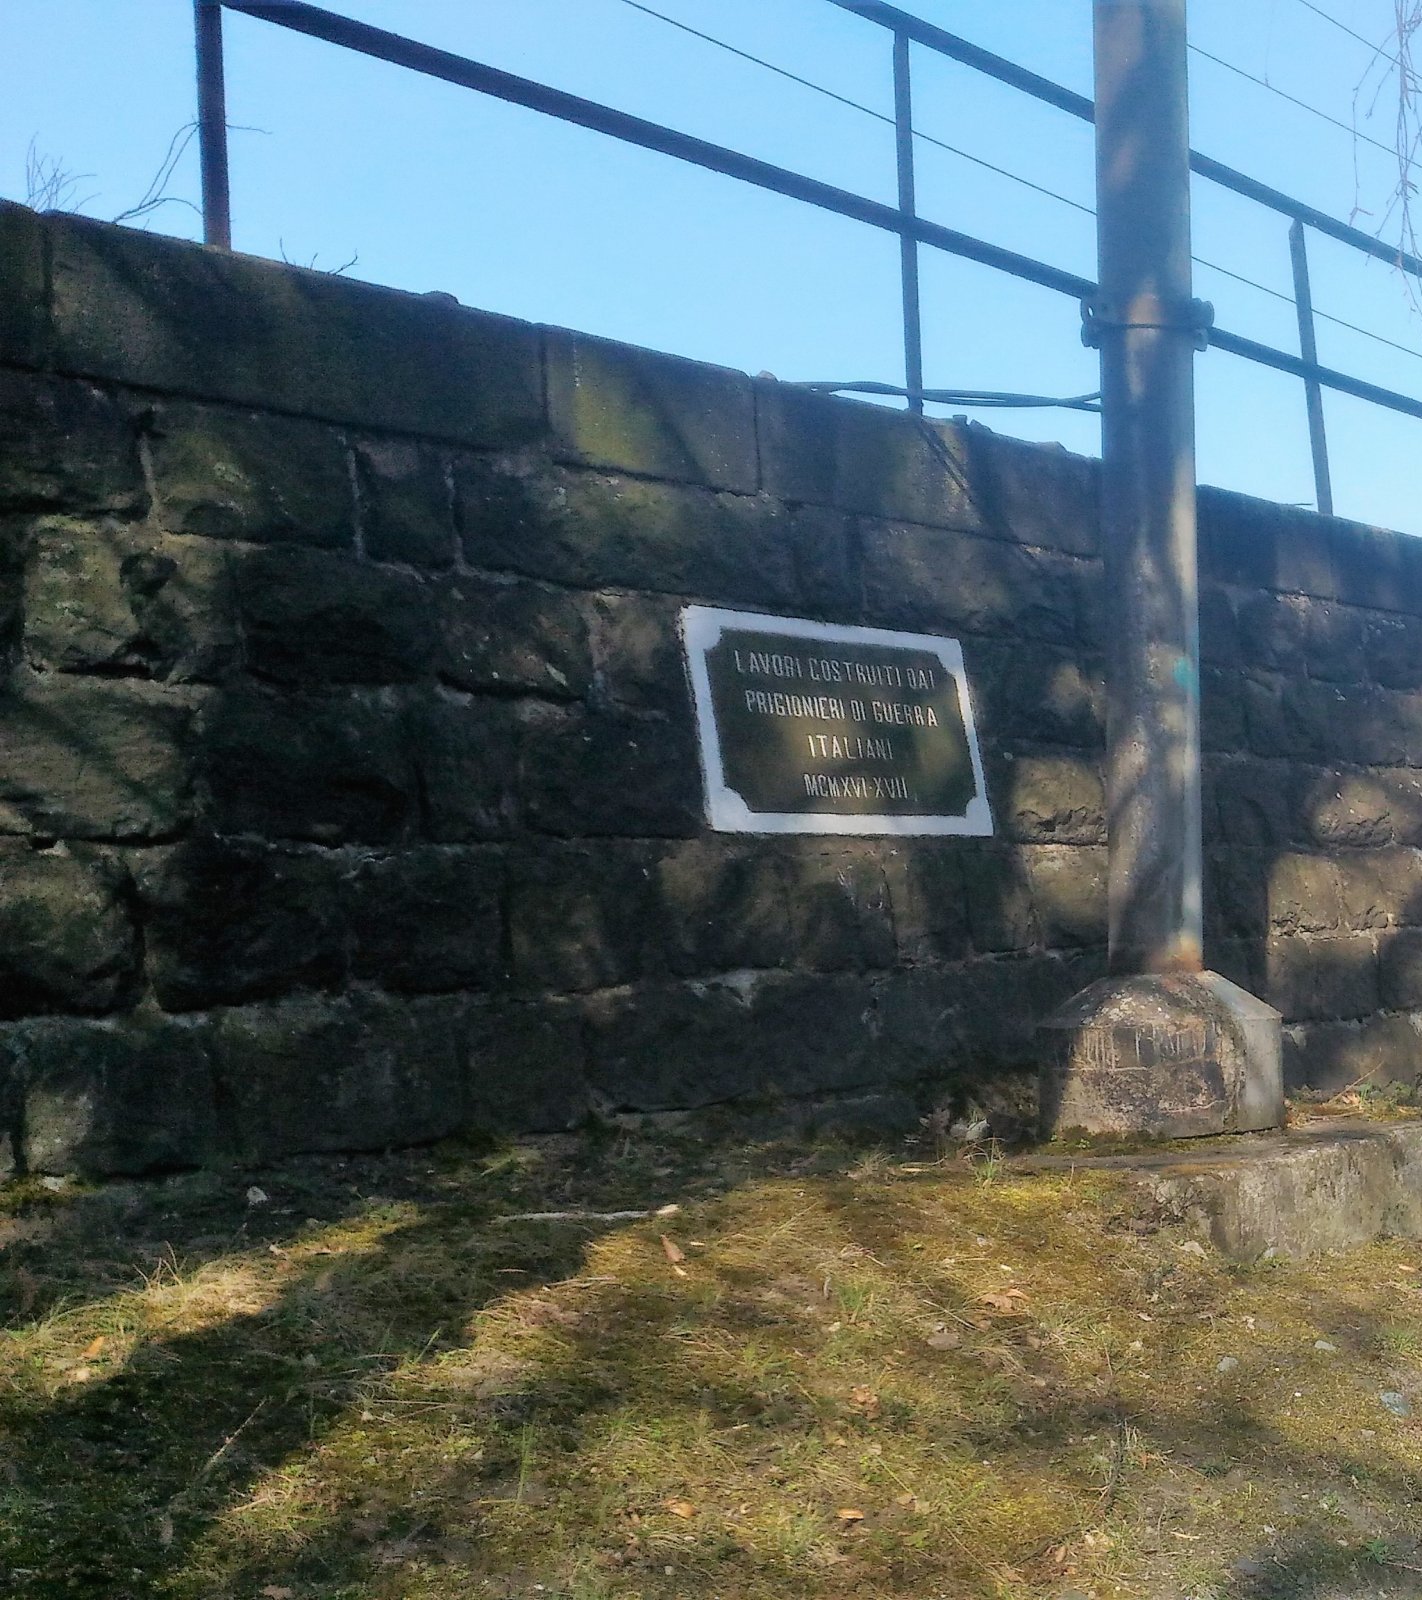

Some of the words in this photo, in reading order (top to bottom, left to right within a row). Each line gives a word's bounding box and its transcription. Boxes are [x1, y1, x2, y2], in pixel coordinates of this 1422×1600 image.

[734, 649, 803, 678] LAVORI
[808, 657, 902, 687] COSTRUITI
[906, 667, 935, 690] DAI
[745, 689, 846, 720] PRIGIONIERI
[851, 699, 866, 722] DI
[872, 701, 939, 728] GUERRA
[807, 734, 894, 760] ITALIANI
